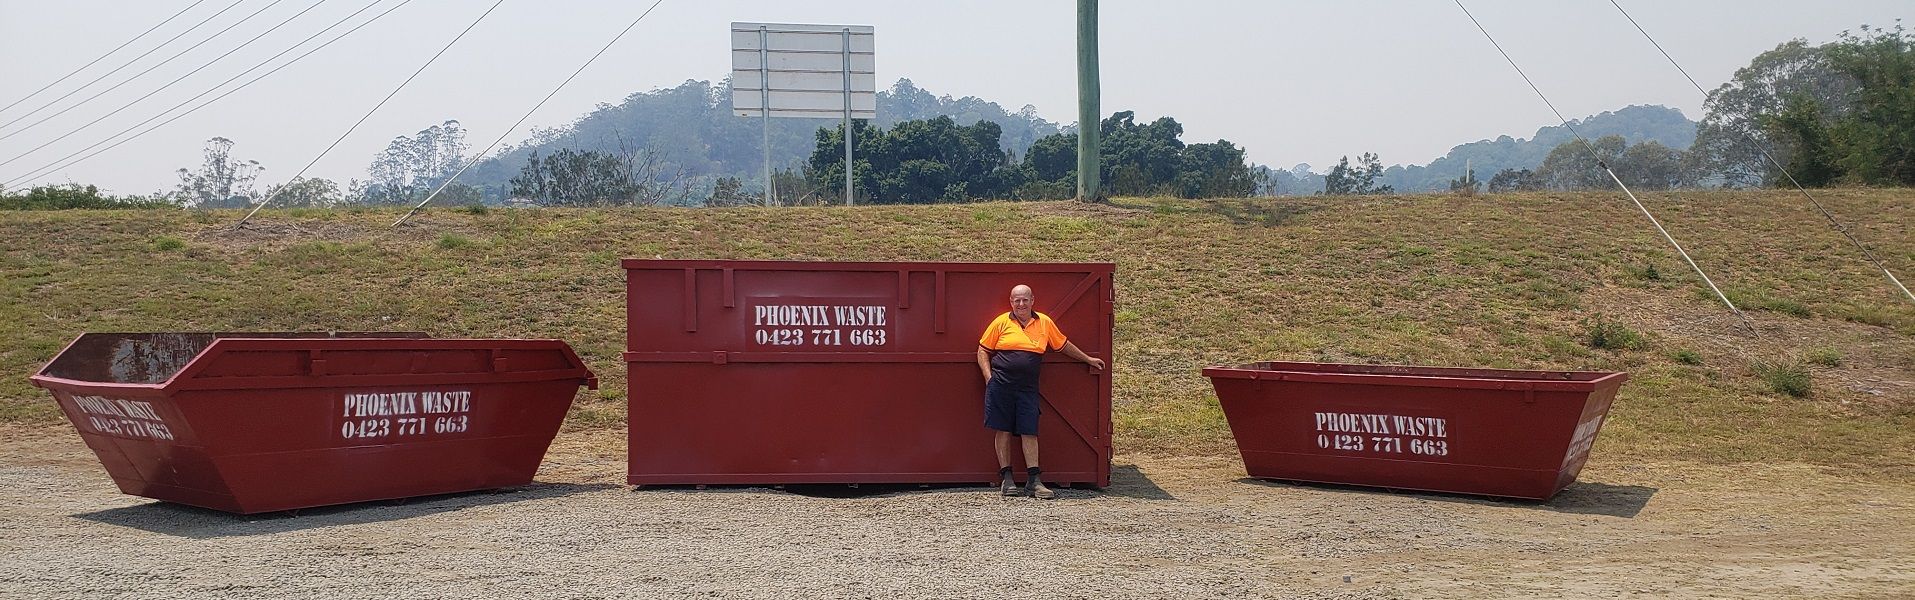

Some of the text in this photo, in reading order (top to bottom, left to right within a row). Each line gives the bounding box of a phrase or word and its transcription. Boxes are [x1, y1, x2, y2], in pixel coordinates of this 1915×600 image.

[755, 305, 886, 326] PHOENIX WASTE
[755, 329, 886, 346] 0423 771 663
[116, 399, 162, 421] WASTE
[343, 391, 471, 417] PHOENIX WASTE
[89, 416, 174, 441] 0423 771 663
[342, 415, 468, 439] 0423 771 663
[1315, 412, 1448, 438] PHOENIX WASTE
[1371, 436, 1403, 453] 771
[1410, 438, 1448, 456] 663
